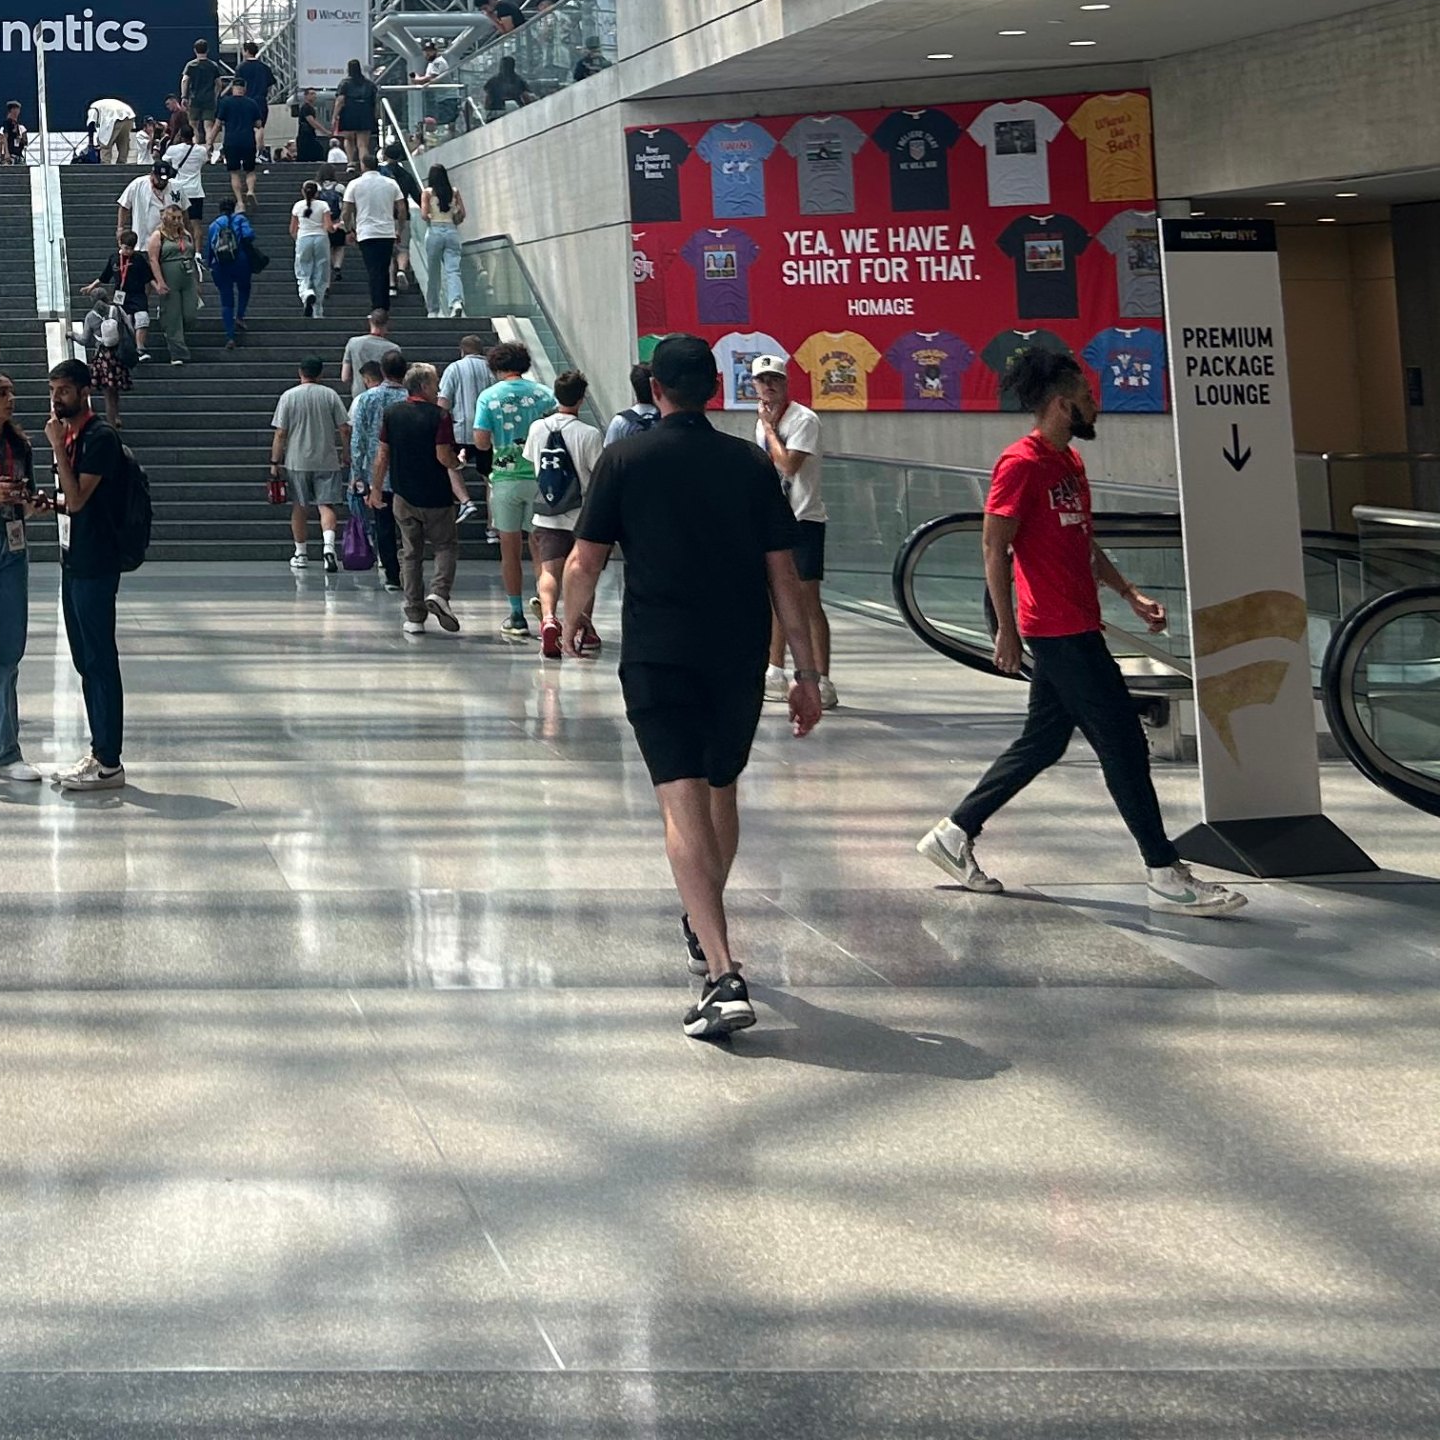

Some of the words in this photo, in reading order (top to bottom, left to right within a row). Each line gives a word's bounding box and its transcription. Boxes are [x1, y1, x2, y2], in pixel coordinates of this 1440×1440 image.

[783, 230, 835, 257] YEA,
[841, 228, 880, 253] WE
[888, 225, 951, 253] HAVE
[958, 224, 976, 250] A
[782, 259, 852, 285] SHIRT
[860, 257, 909, 284] FOR
[915, 255, 981, 281] THAT.
[848, 298, 914, 316] HOMAGE
[1182, 327, 1273, 349] PREMIUM
[1186, 355, 1275, 377] PACKAGE
[1194, 383, 1271, 406] LOUNGE
